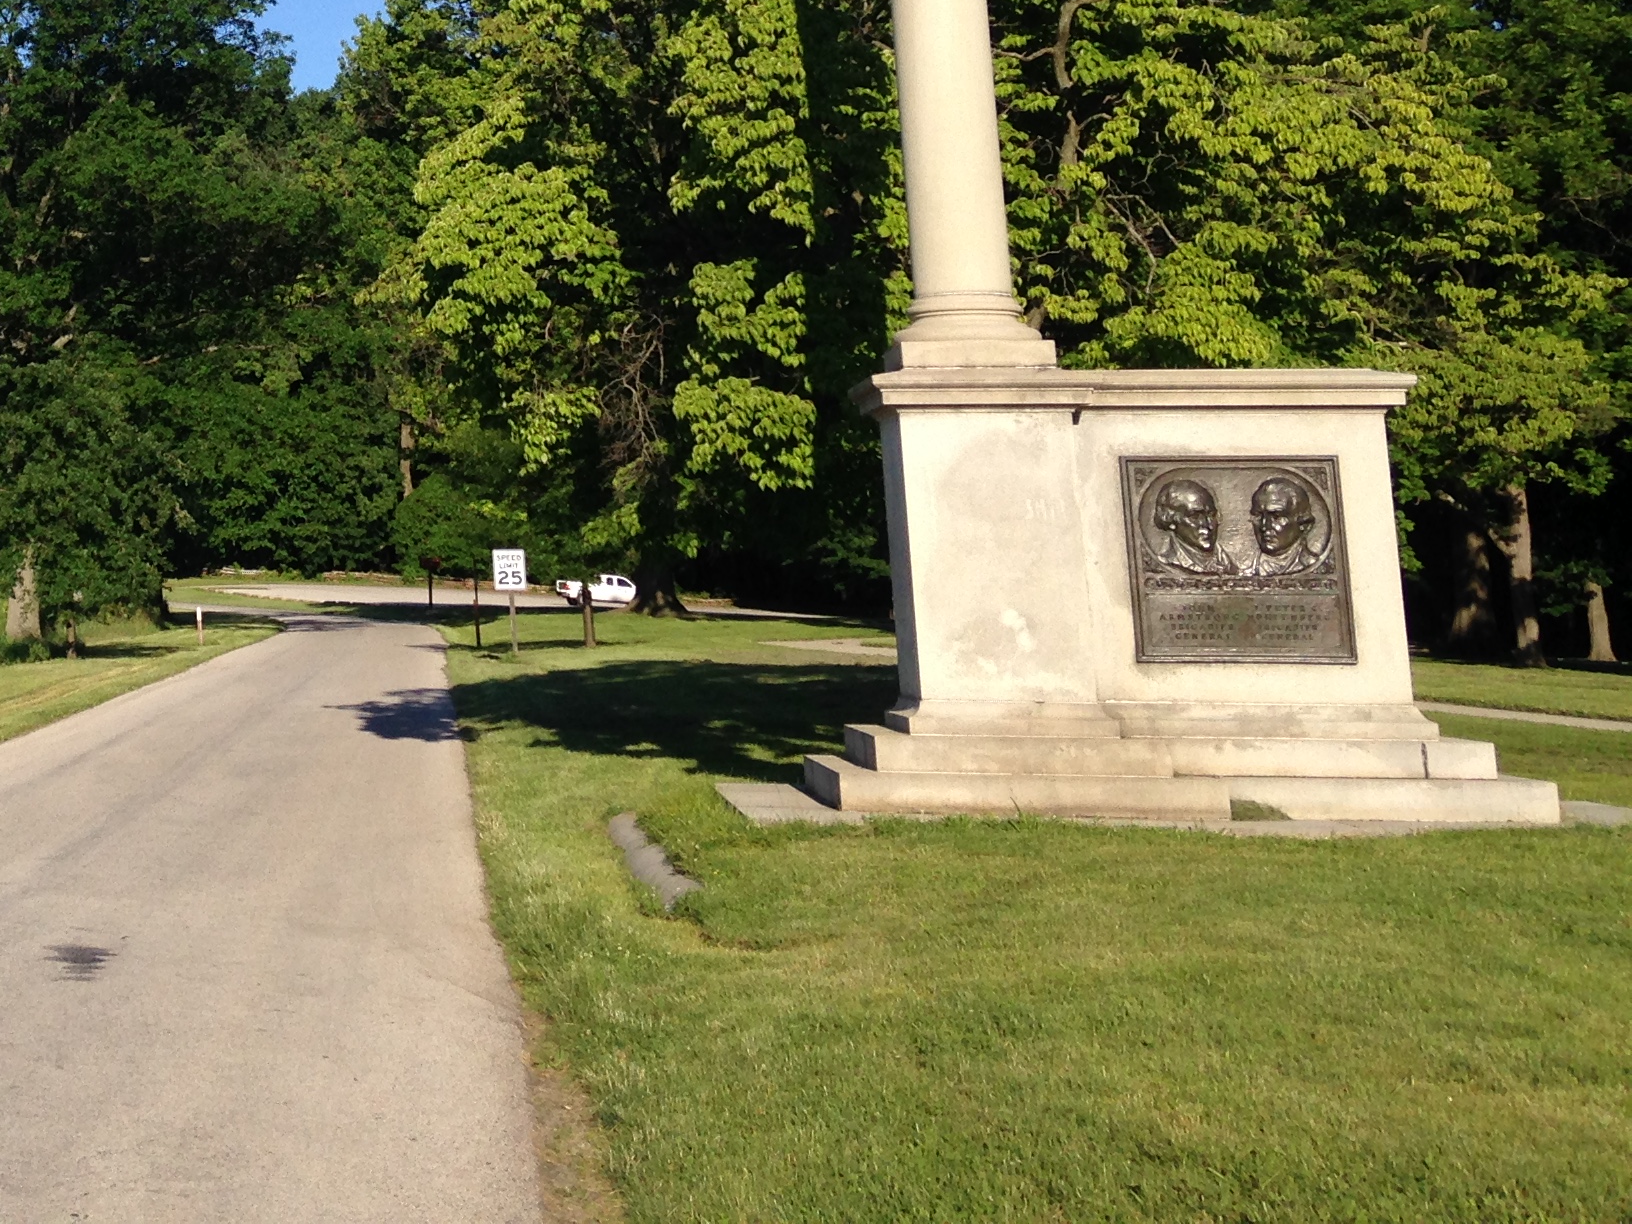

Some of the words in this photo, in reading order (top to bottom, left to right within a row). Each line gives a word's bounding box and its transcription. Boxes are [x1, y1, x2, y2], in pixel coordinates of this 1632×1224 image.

[498, 570, 523, 585] 25
[1159, 613, 1239, 622] ARMSTRONG
[1175, 633, 1231, 641] GENERAL
[1261, 633, 1314, 641] GENERAL
